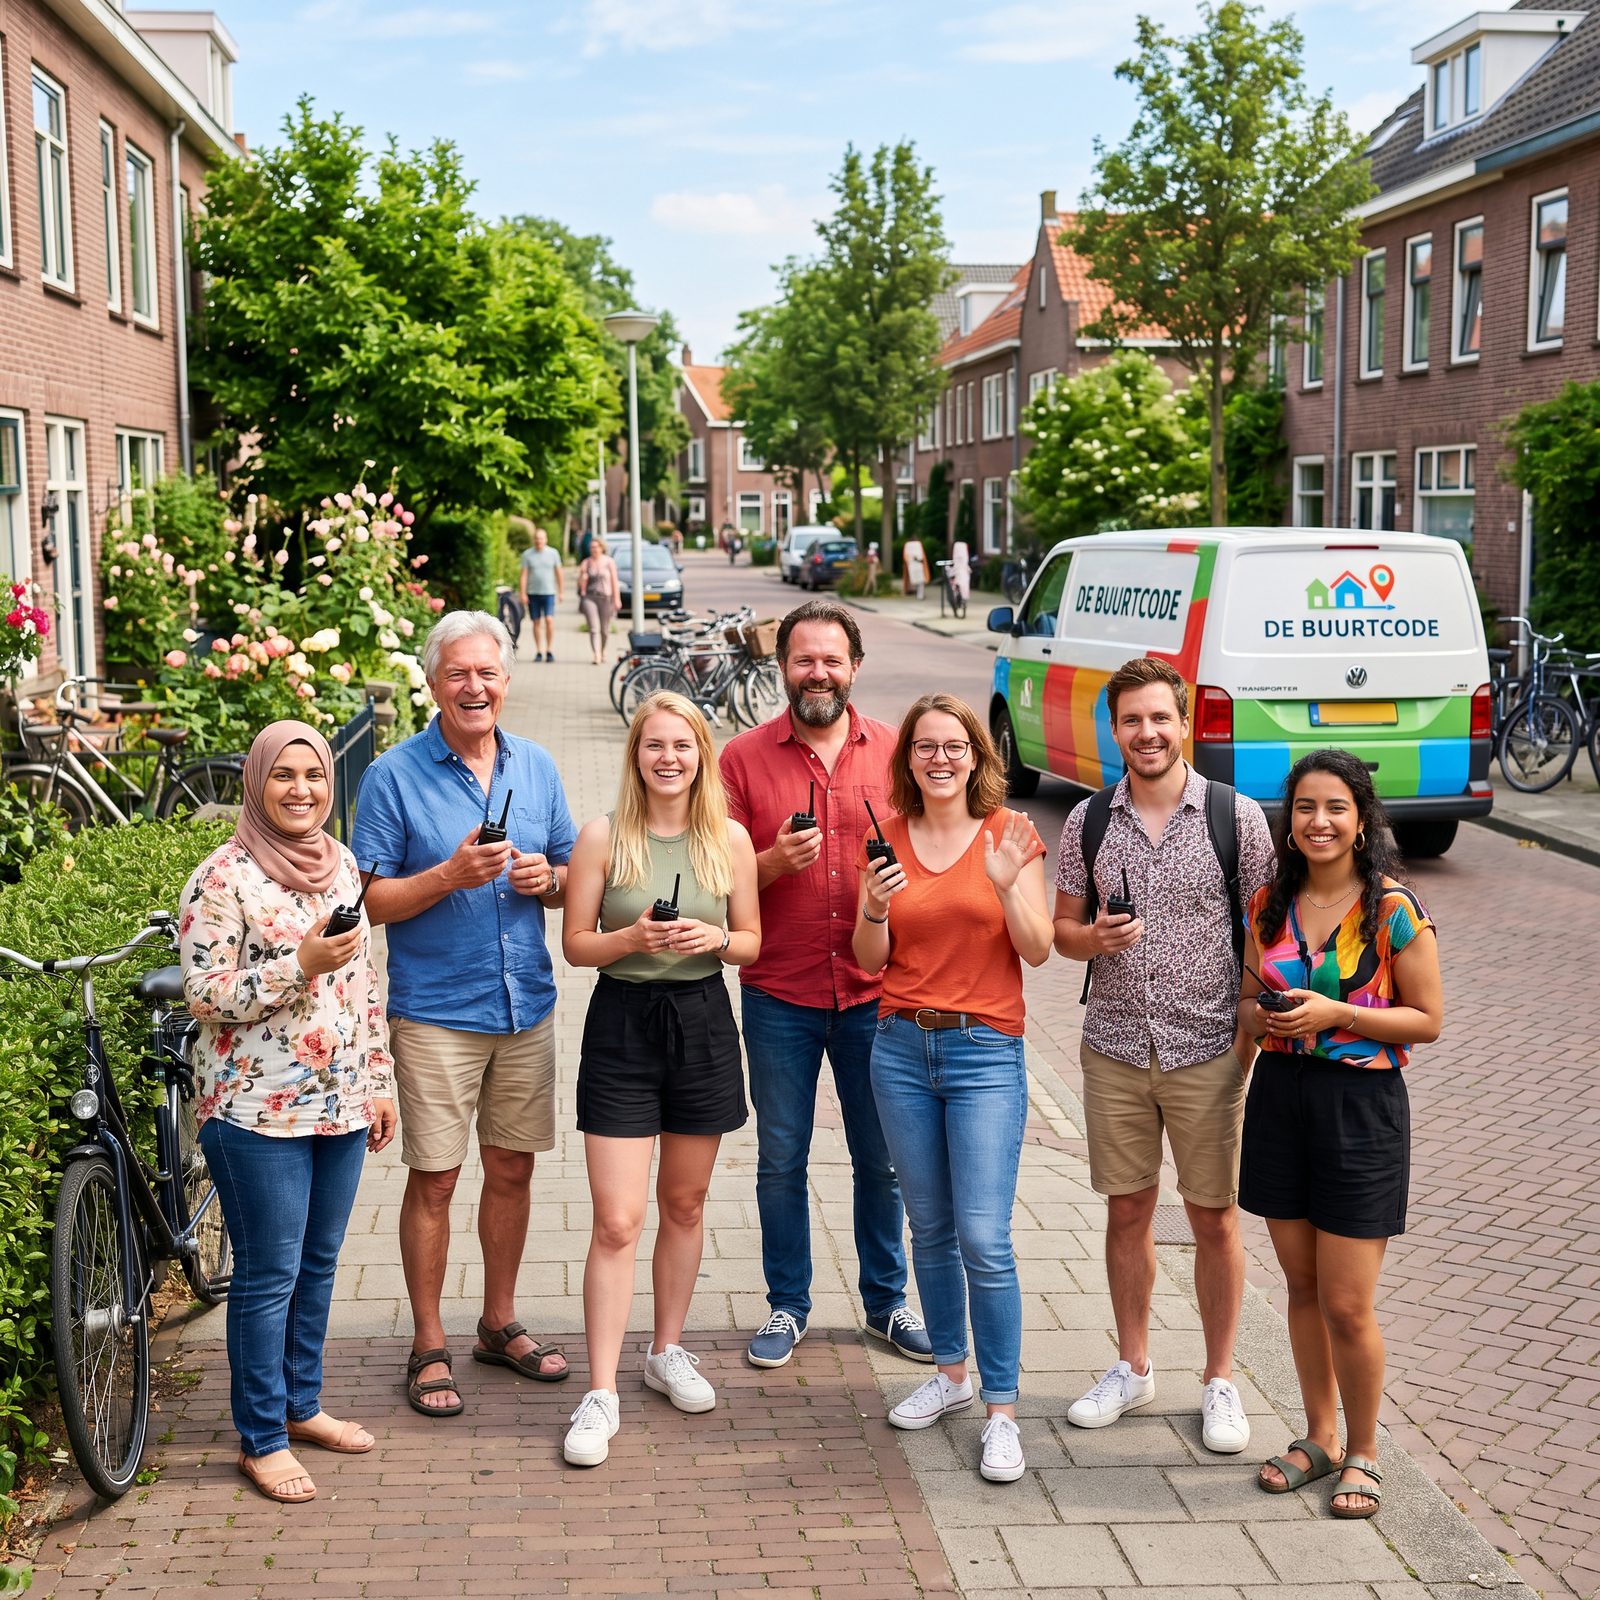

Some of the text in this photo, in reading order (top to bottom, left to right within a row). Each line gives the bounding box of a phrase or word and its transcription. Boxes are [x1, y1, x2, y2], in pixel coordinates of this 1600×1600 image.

[1075, 585, 1182, 621] DE BUURTCODE
[1264, 619, 1440, 638] DE BUURTCODE
